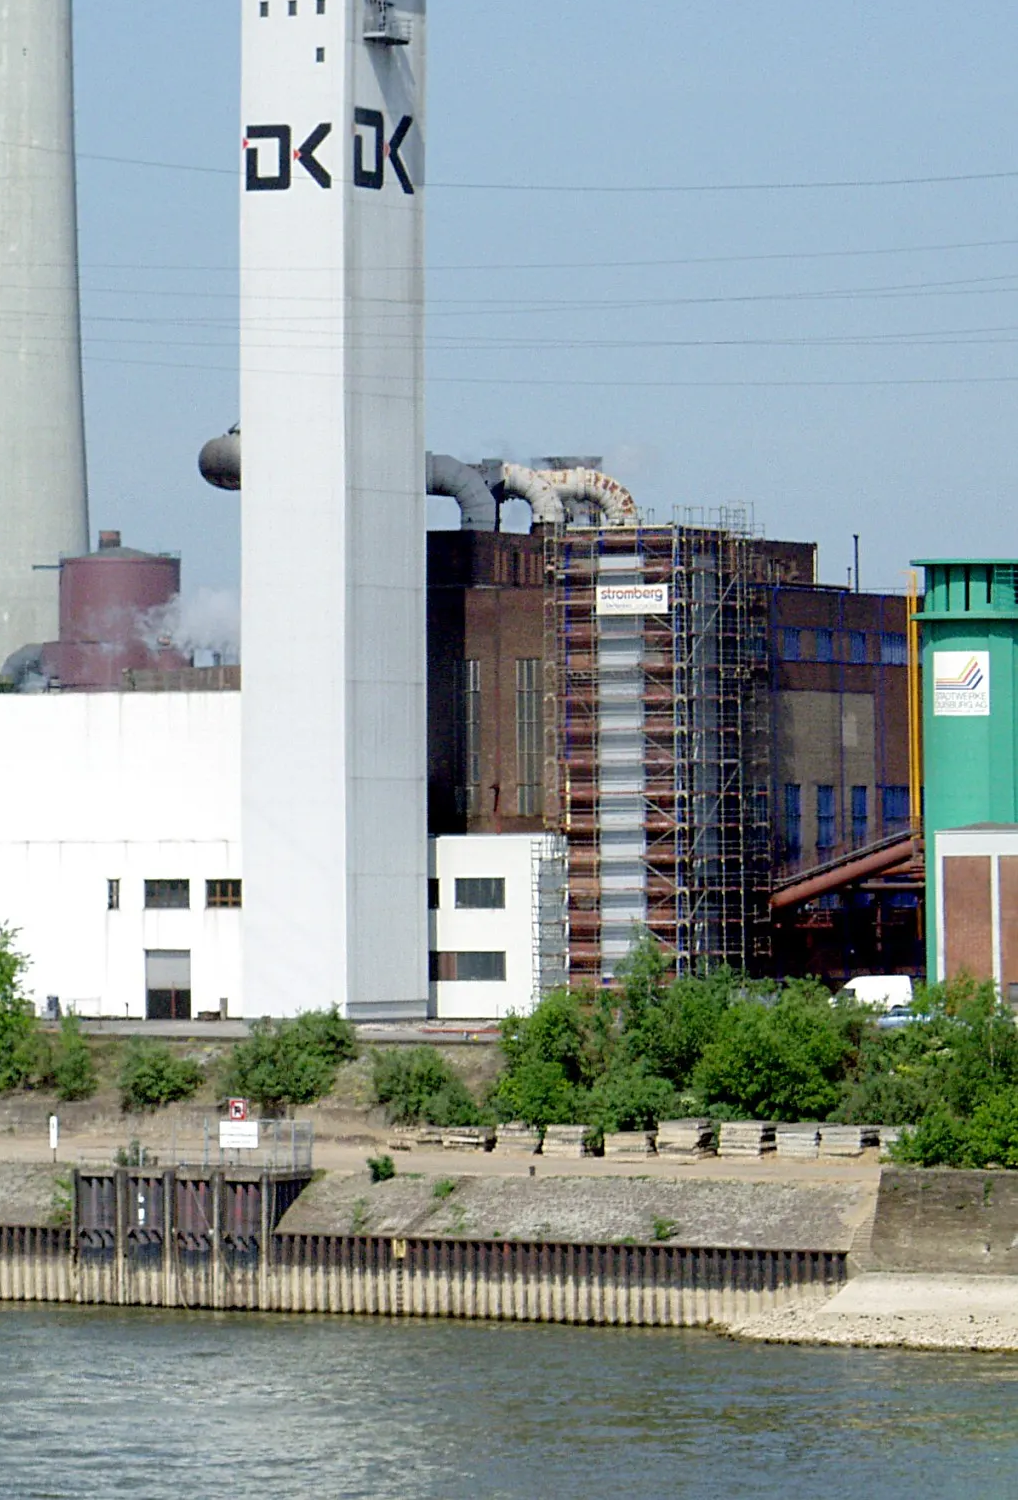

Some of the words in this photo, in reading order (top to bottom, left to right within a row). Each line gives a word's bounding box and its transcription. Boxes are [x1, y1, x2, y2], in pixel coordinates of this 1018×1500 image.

[246, 123, 332, 191] DK
[353, 107, 415, 194] DK
[600, 587, 663, 601] stromberg
